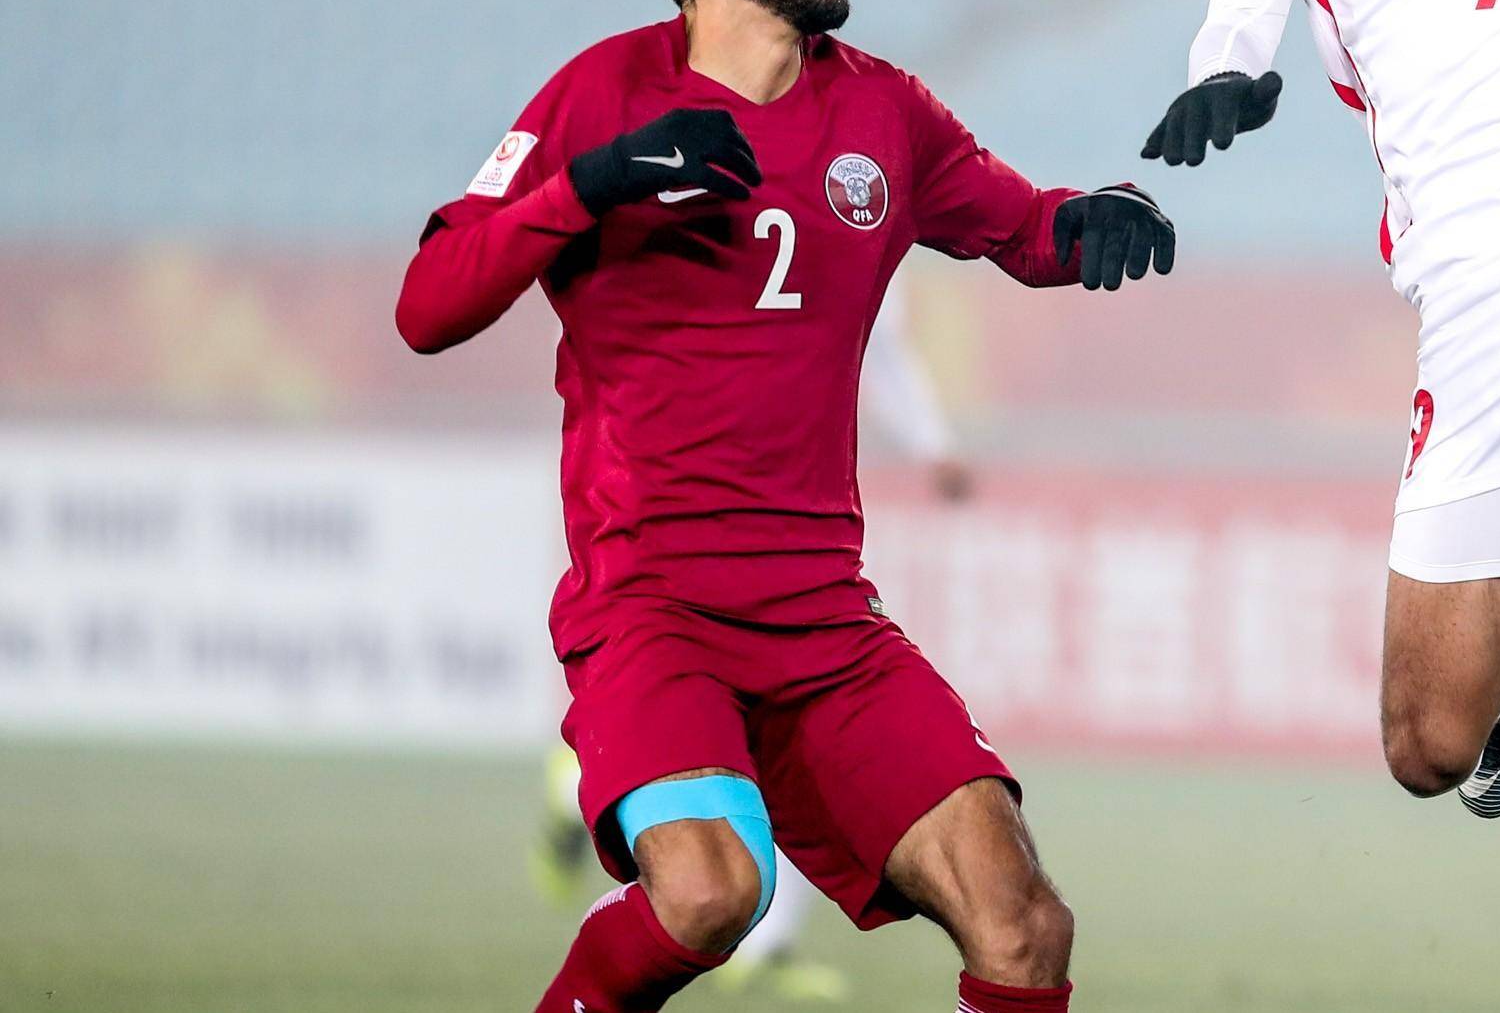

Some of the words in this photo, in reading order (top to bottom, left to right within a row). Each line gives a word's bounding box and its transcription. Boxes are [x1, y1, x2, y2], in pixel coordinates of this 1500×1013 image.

[754, 208, 802, 309] 2
[852, 209, 874, 222] QFA
[1406, 388, 1434, 479] 9
